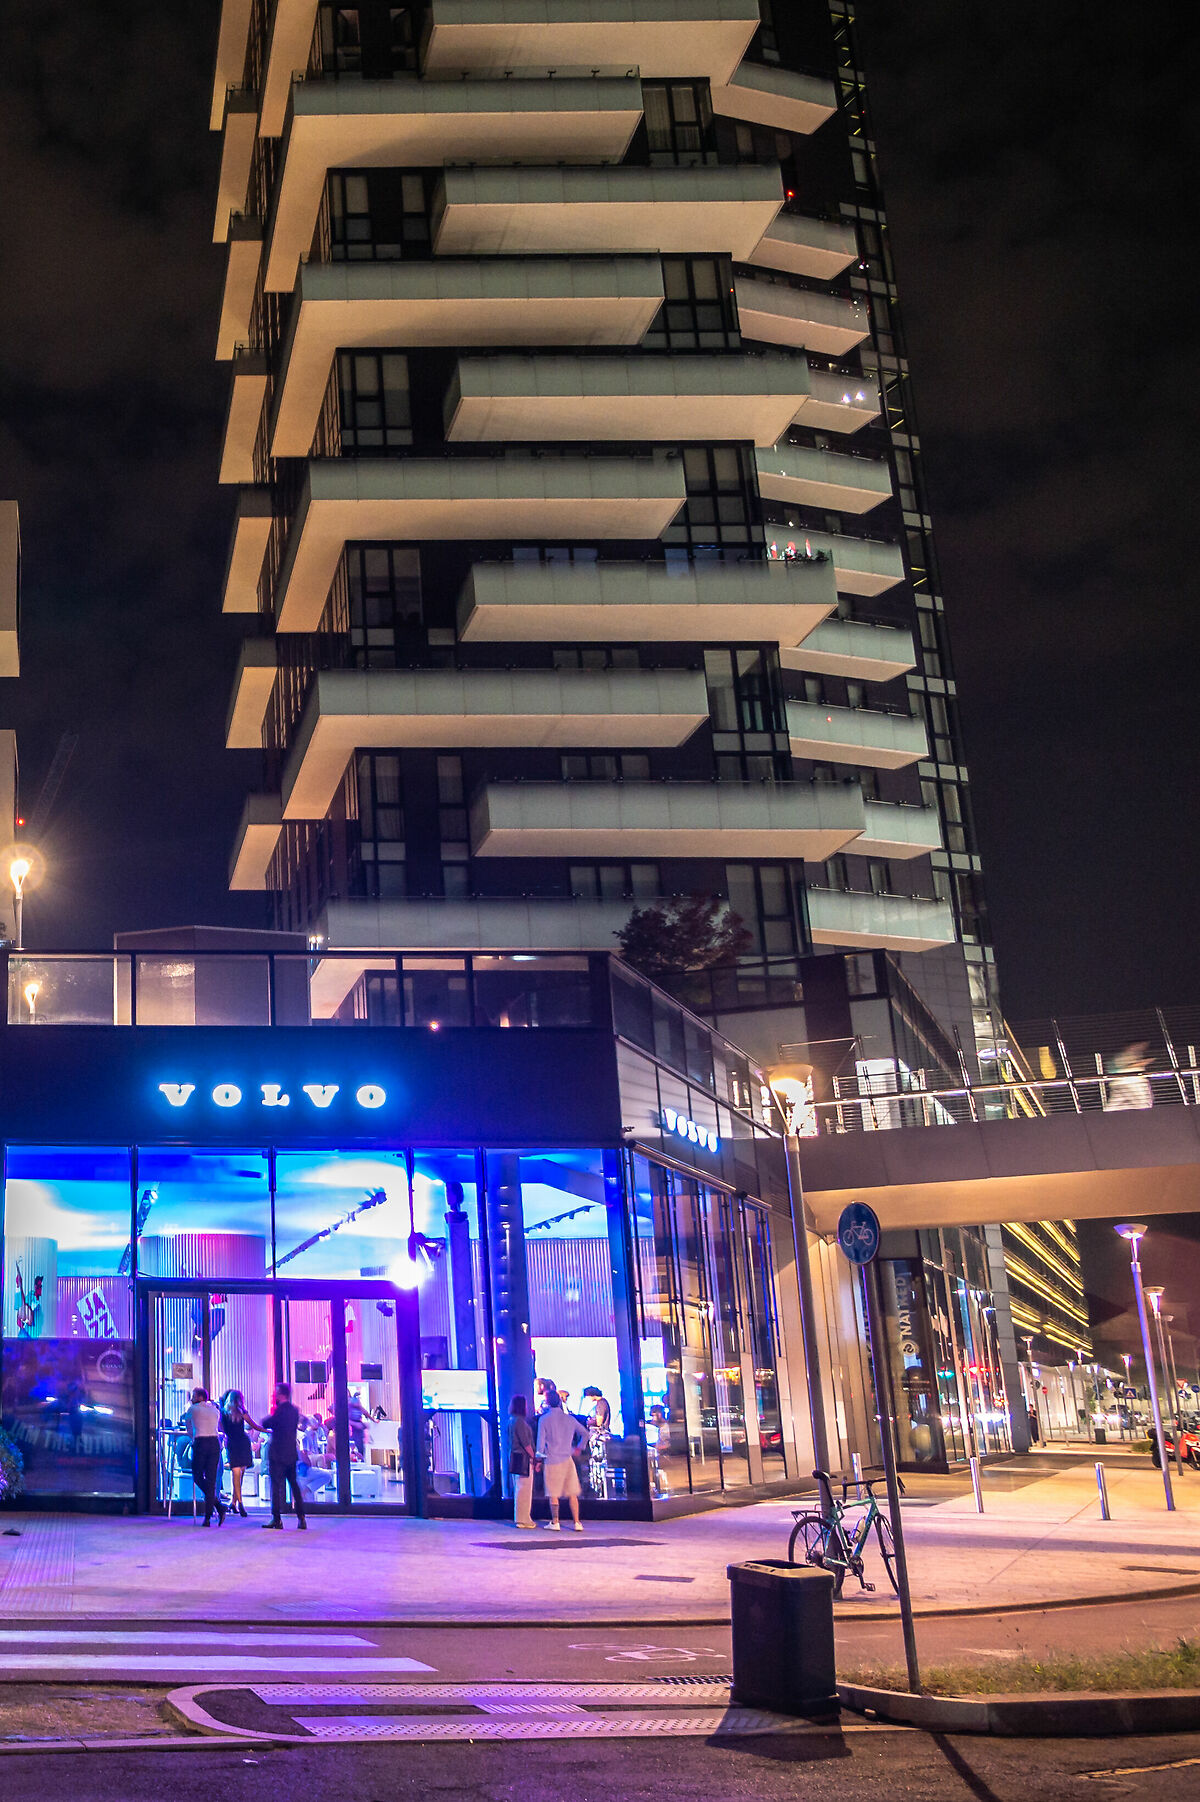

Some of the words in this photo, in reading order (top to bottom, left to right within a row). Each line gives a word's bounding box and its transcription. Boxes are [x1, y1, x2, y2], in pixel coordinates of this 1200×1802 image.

[158, 1083, 387, 1108] VOLVO
[663, 1108, 718, 1152] VOLVO
[84, 1292, 105, 1321] JA
